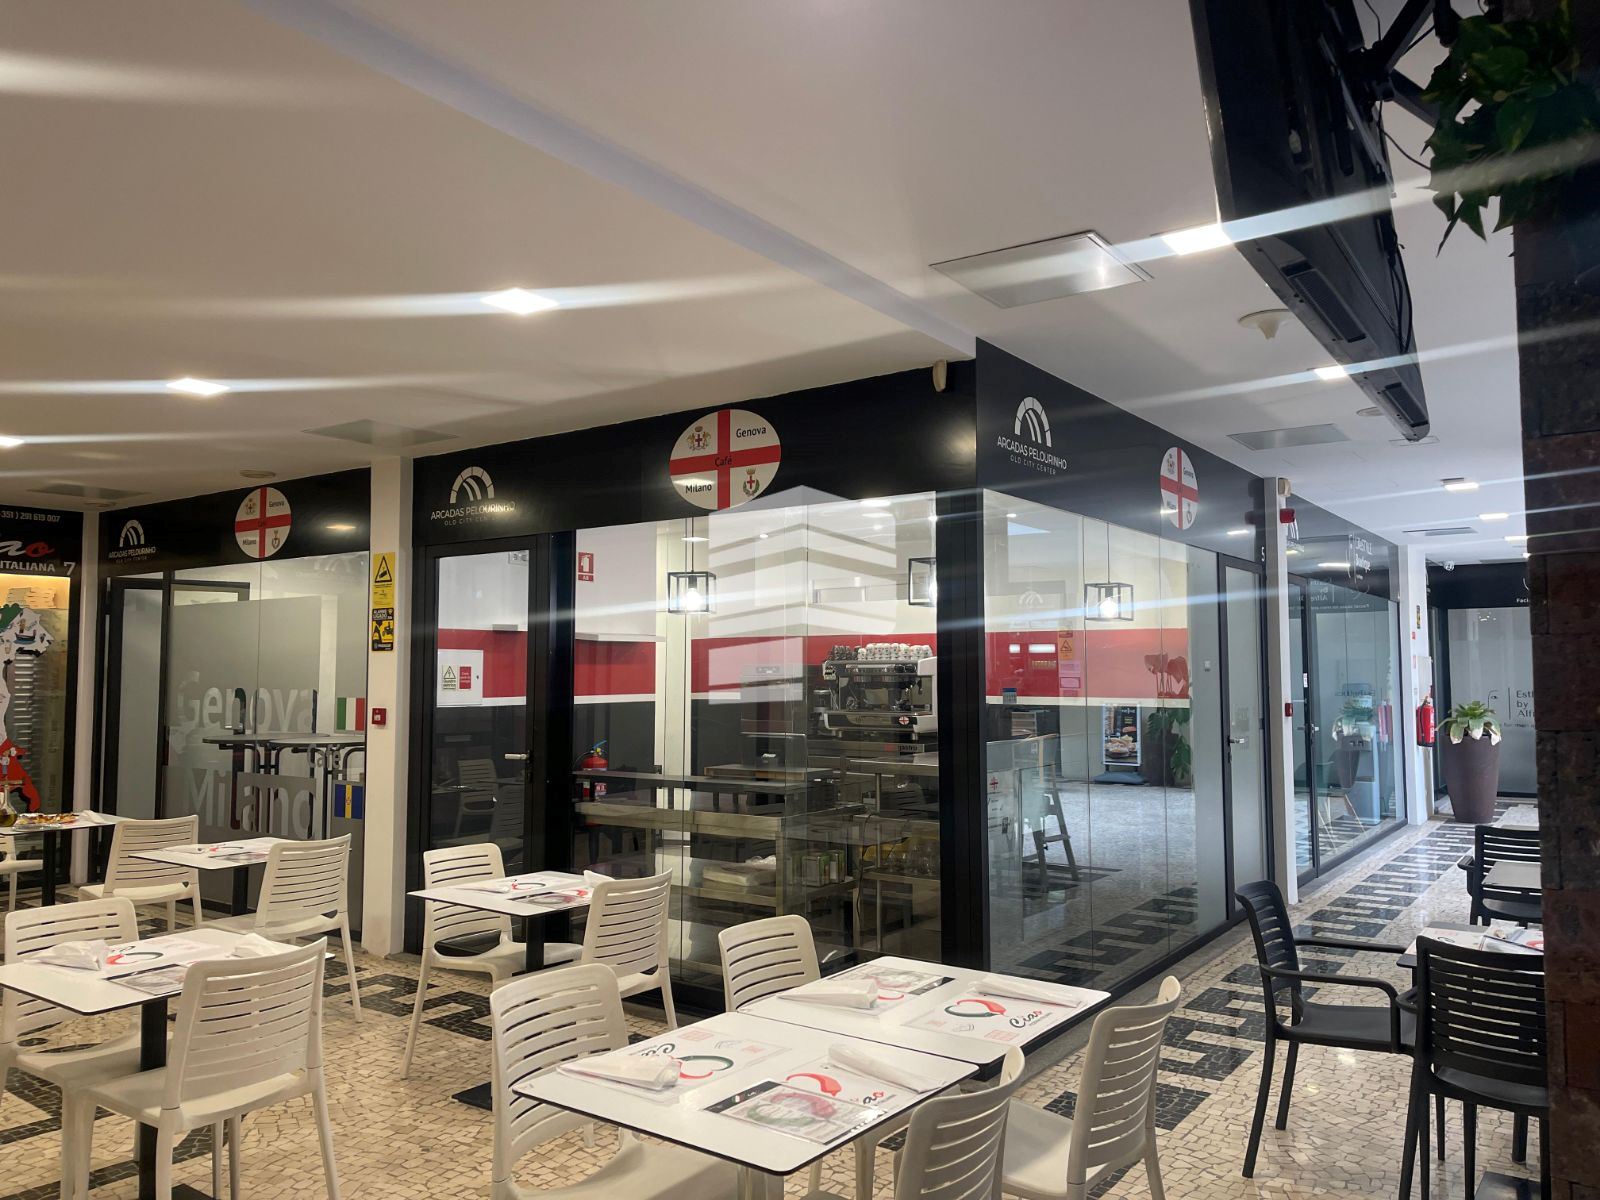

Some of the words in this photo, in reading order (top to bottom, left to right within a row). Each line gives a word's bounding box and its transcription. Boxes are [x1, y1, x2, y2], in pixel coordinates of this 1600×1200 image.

[735, 426, 767, 438] Genova
[997, 435, 1029, 456] ARCADAS
[1028, 446, 1068, 470] PELOURINHO
[714, 456, 733, 467] Café
[1010, 454, 1022, 464] OLD
[1023, 459, 1035, 468] CITY
[1036, 463, 1057, 475] CENTER
[685, 483, 712, 494] Milano
[431, 508, 465, 520] ARCADAS
[0, 560, 56, 572] ITALIANA
[63, 561, 76, 576] 7
[176, 671, 319, 734] Genova
[1516, 700, 1529, 709] by
[186, 767, 319, 841] Milano
